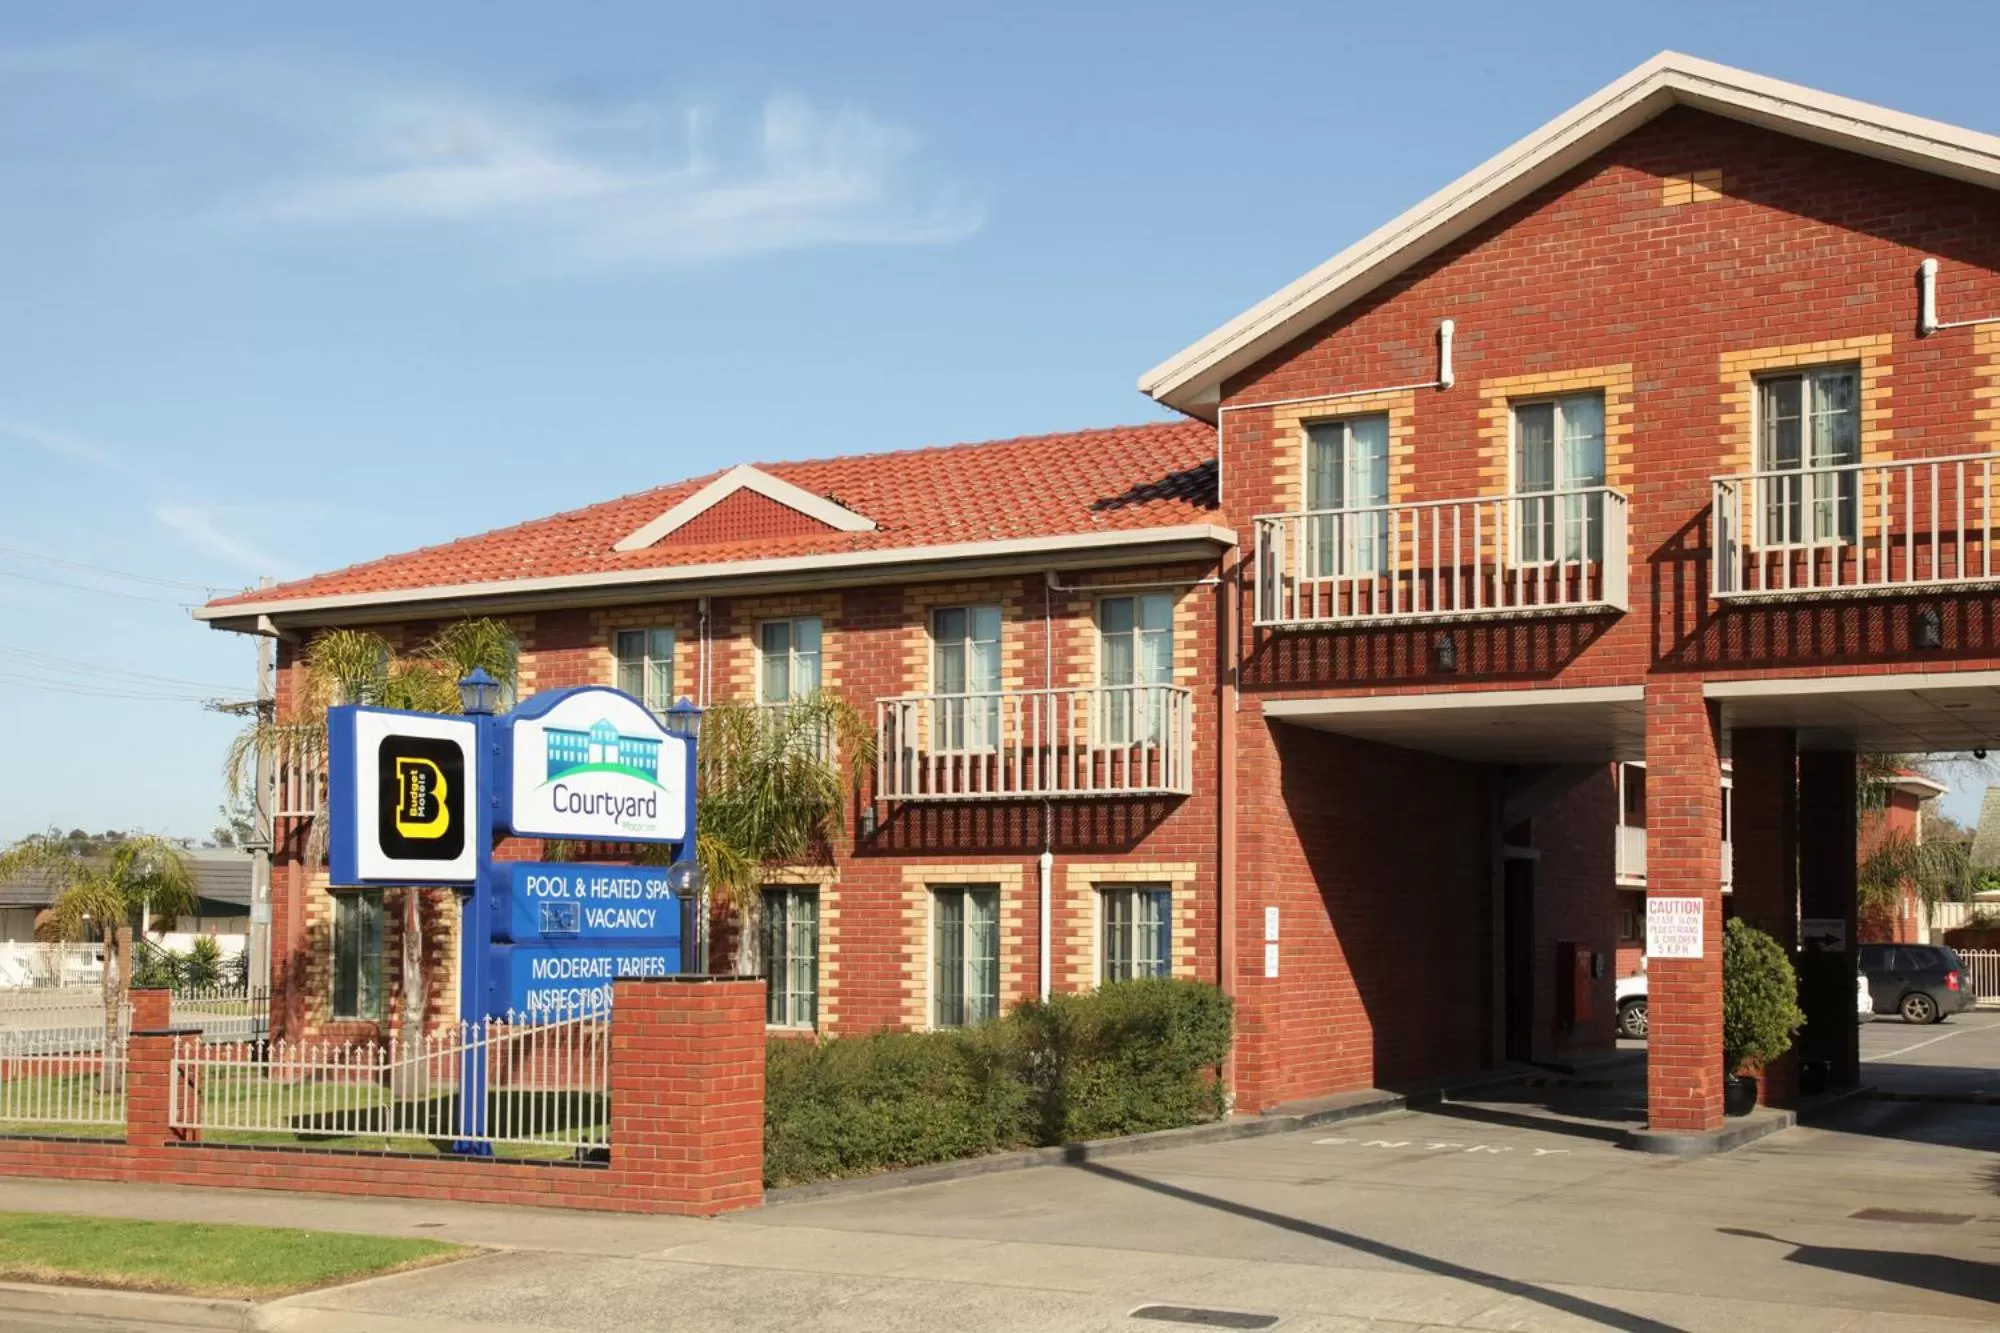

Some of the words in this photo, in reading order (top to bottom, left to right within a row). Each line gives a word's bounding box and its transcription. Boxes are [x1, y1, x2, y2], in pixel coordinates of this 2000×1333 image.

[410, 768, 418, 817] Budget
[418, 773, 426, 817] Motels
[553, 783, 657, 825] Courtyard
[527, 876, 570, 897] POOL
[575, 878, 586, 897] &
[591, 878, 642, 899] HEATED
[646, 880, 670, 899] SPA
[1649, 900, 1701, 914] CAUTION
[585, 908, 656, 929] VACANCY
[1648, 915, 1674, 925] PLEASE
[1650, 925, 1698, 934] PEDESTRIANS
[1662, 935, 1697, 945] CHILDREN
[532, 957, 612, 979] MODERATE
[616, 957, 665, 976] TARIFFS
[527, 986, 613, 1011] INSPECTION
